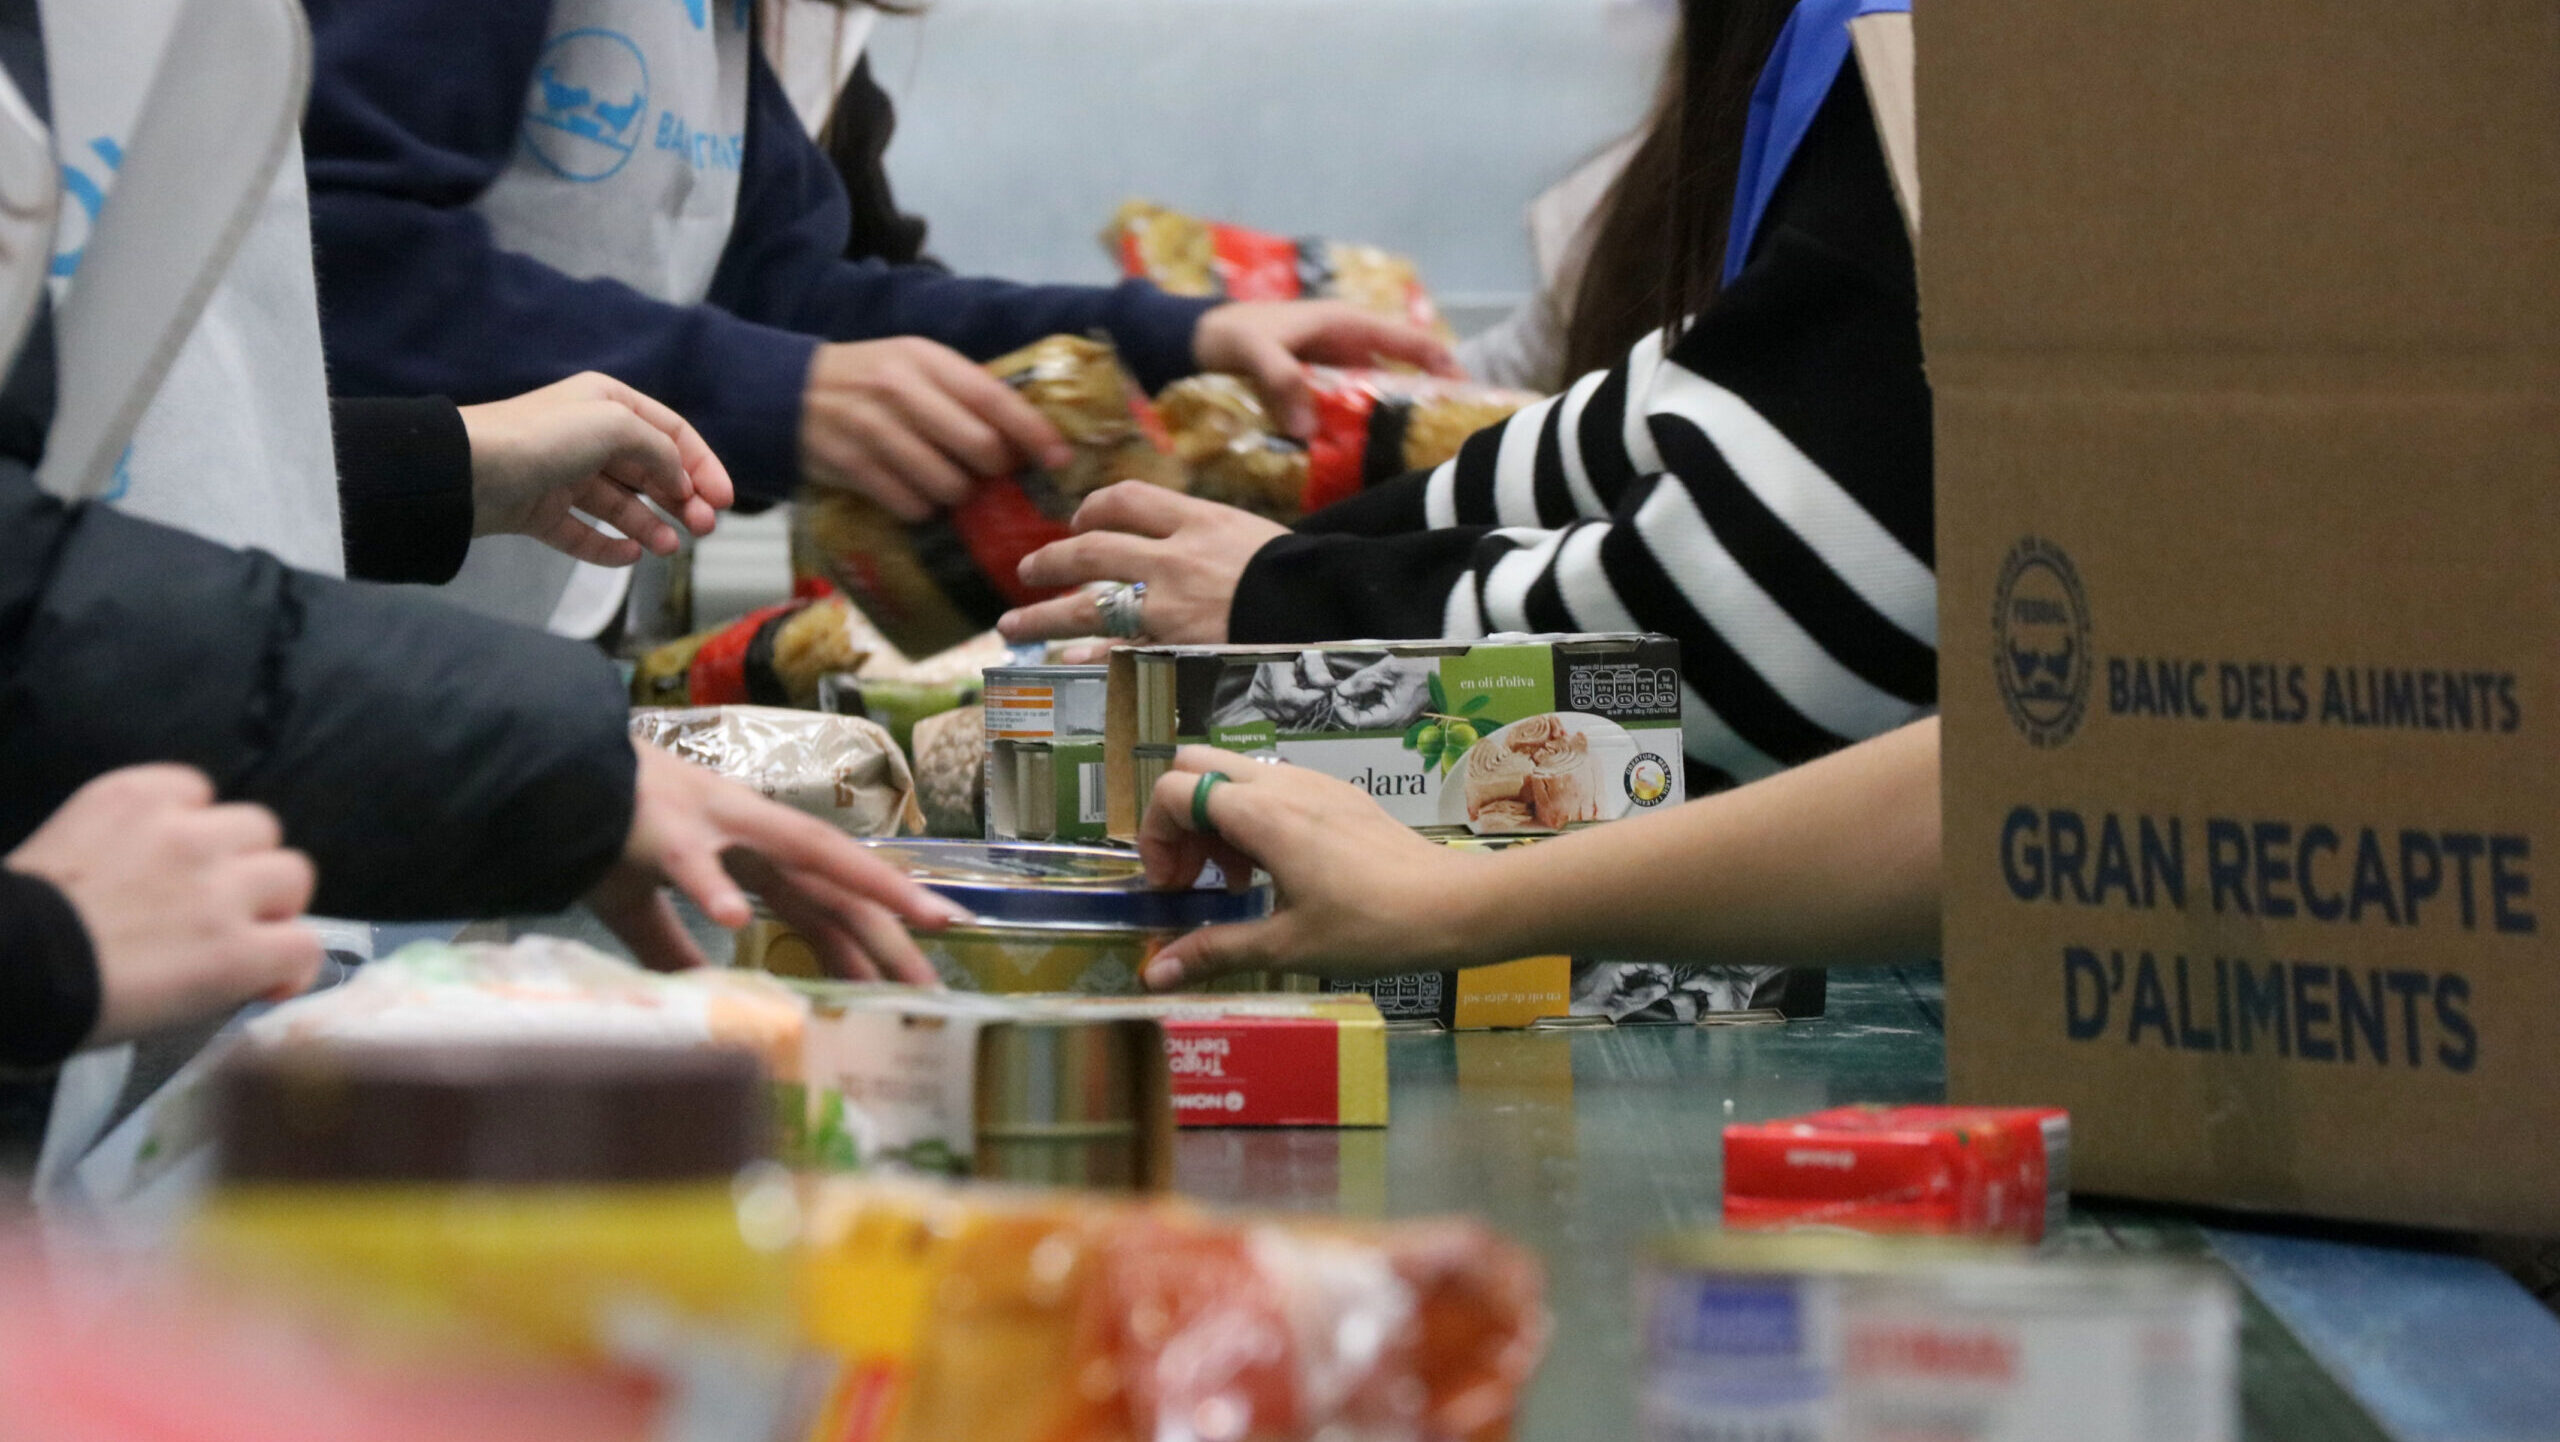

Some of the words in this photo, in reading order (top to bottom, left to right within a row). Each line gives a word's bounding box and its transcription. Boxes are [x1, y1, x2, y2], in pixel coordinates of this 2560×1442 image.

[1460, 679, 1475, 689] en
[1478, 676, 1493, 689] oli
[2109, 656, 2207, 719] BANC
[2220, 662, 2308, 724] DELS
[2320, 666, 2521, 733] ALIMENTS
[1221, 732, 1267, 744] bonpreu
[2002, 807, 2186, 911] GRAN
[2206, 818, 2538, 934] RECAPTE
[2064, 945, 2478, 1074] D'ALIMENTS
[1168, 1050, 1225, 1077] Trigo
